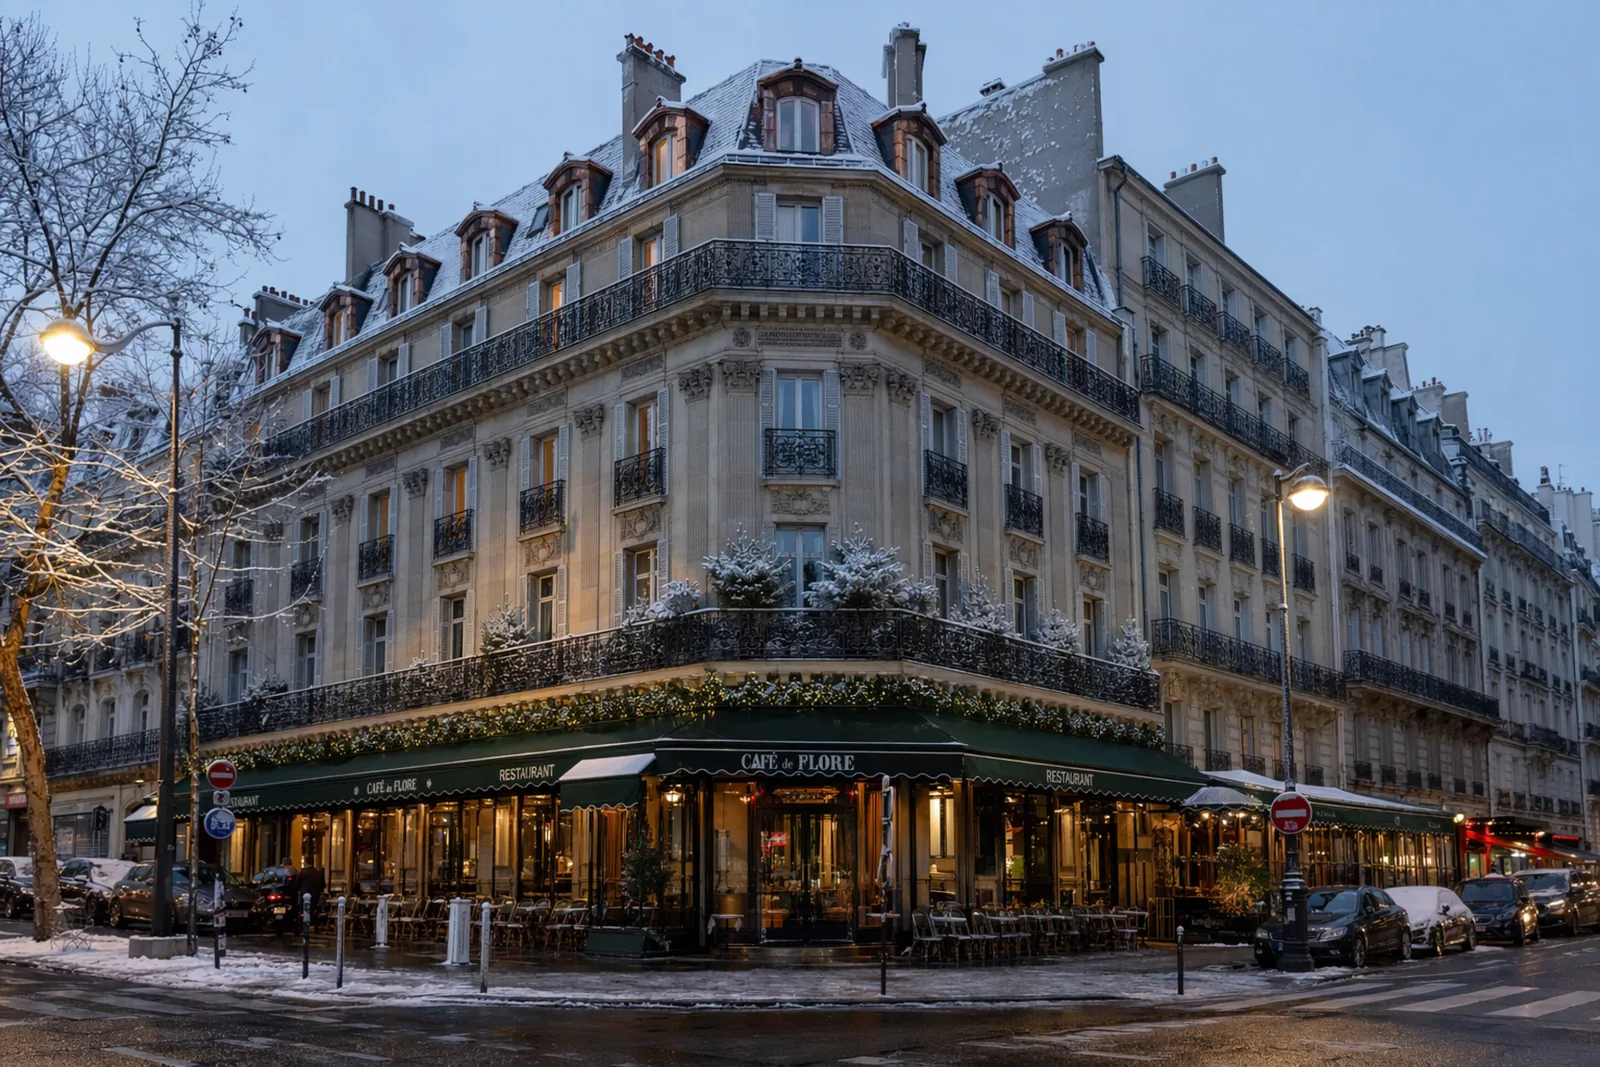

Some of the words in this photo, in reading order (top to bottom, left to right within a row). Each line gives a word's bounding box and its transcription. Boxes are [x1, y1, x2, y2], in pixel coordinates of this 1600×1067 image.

[741, 751, 778, 770] CAFÉ
[782, 758, 793, 769] de
[798, 754, 855, 771] FLORE
[499, 763, 555, 781] RESTAURANT
[1046, 769, 1094, 786] RESTAURANT
[394, 778, 418, 792] FLORE
